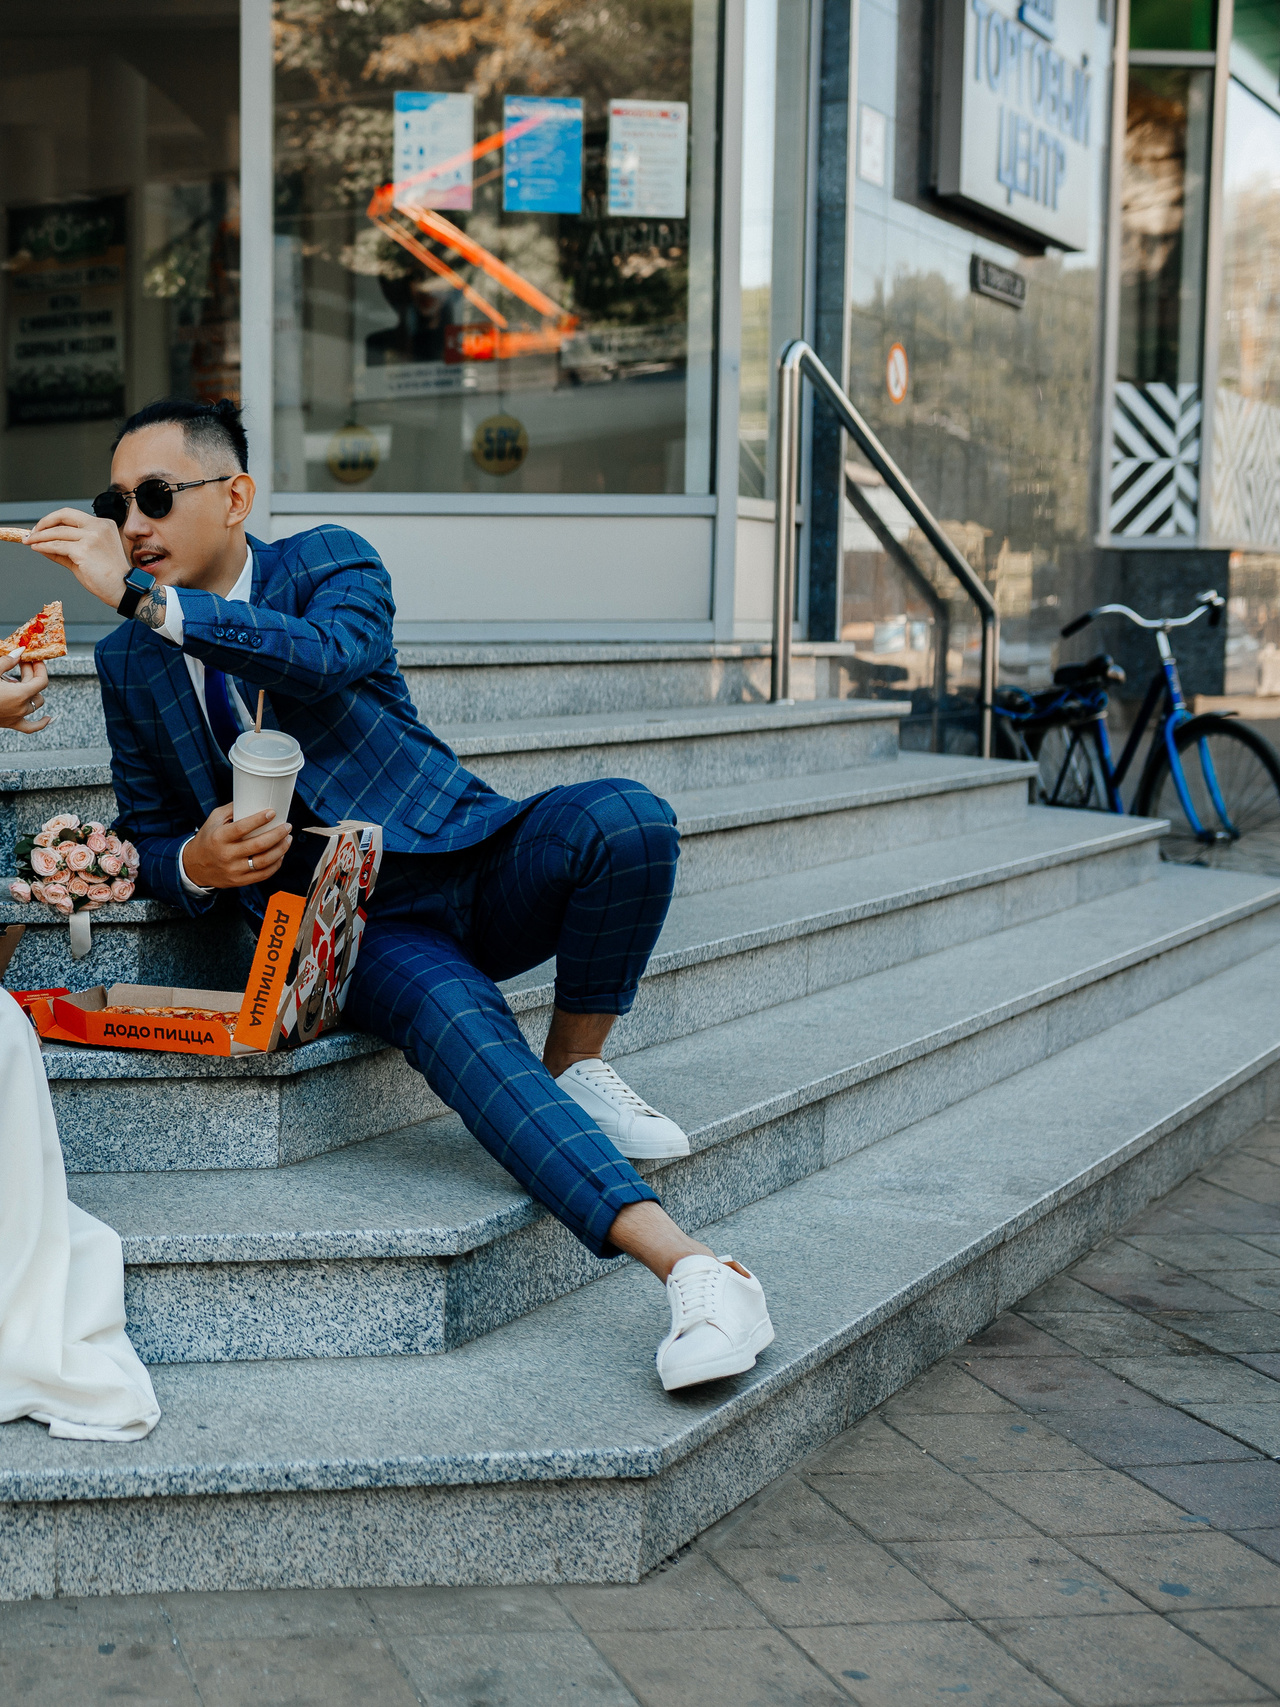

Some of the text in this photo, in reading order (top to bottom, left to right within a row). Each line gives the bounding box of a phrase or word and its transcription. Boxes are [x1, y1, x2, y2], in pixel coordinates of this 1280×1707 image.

[972, 1, 1091, 147] ТОРГОВЫЙ
[997, 104, 1067, 212] ЦЕНТР
[249, 909, 290, 1027] ДОДО ПИЦЦА
[103, 1022, 215, 1046] ДОДО ПИЦЦА
